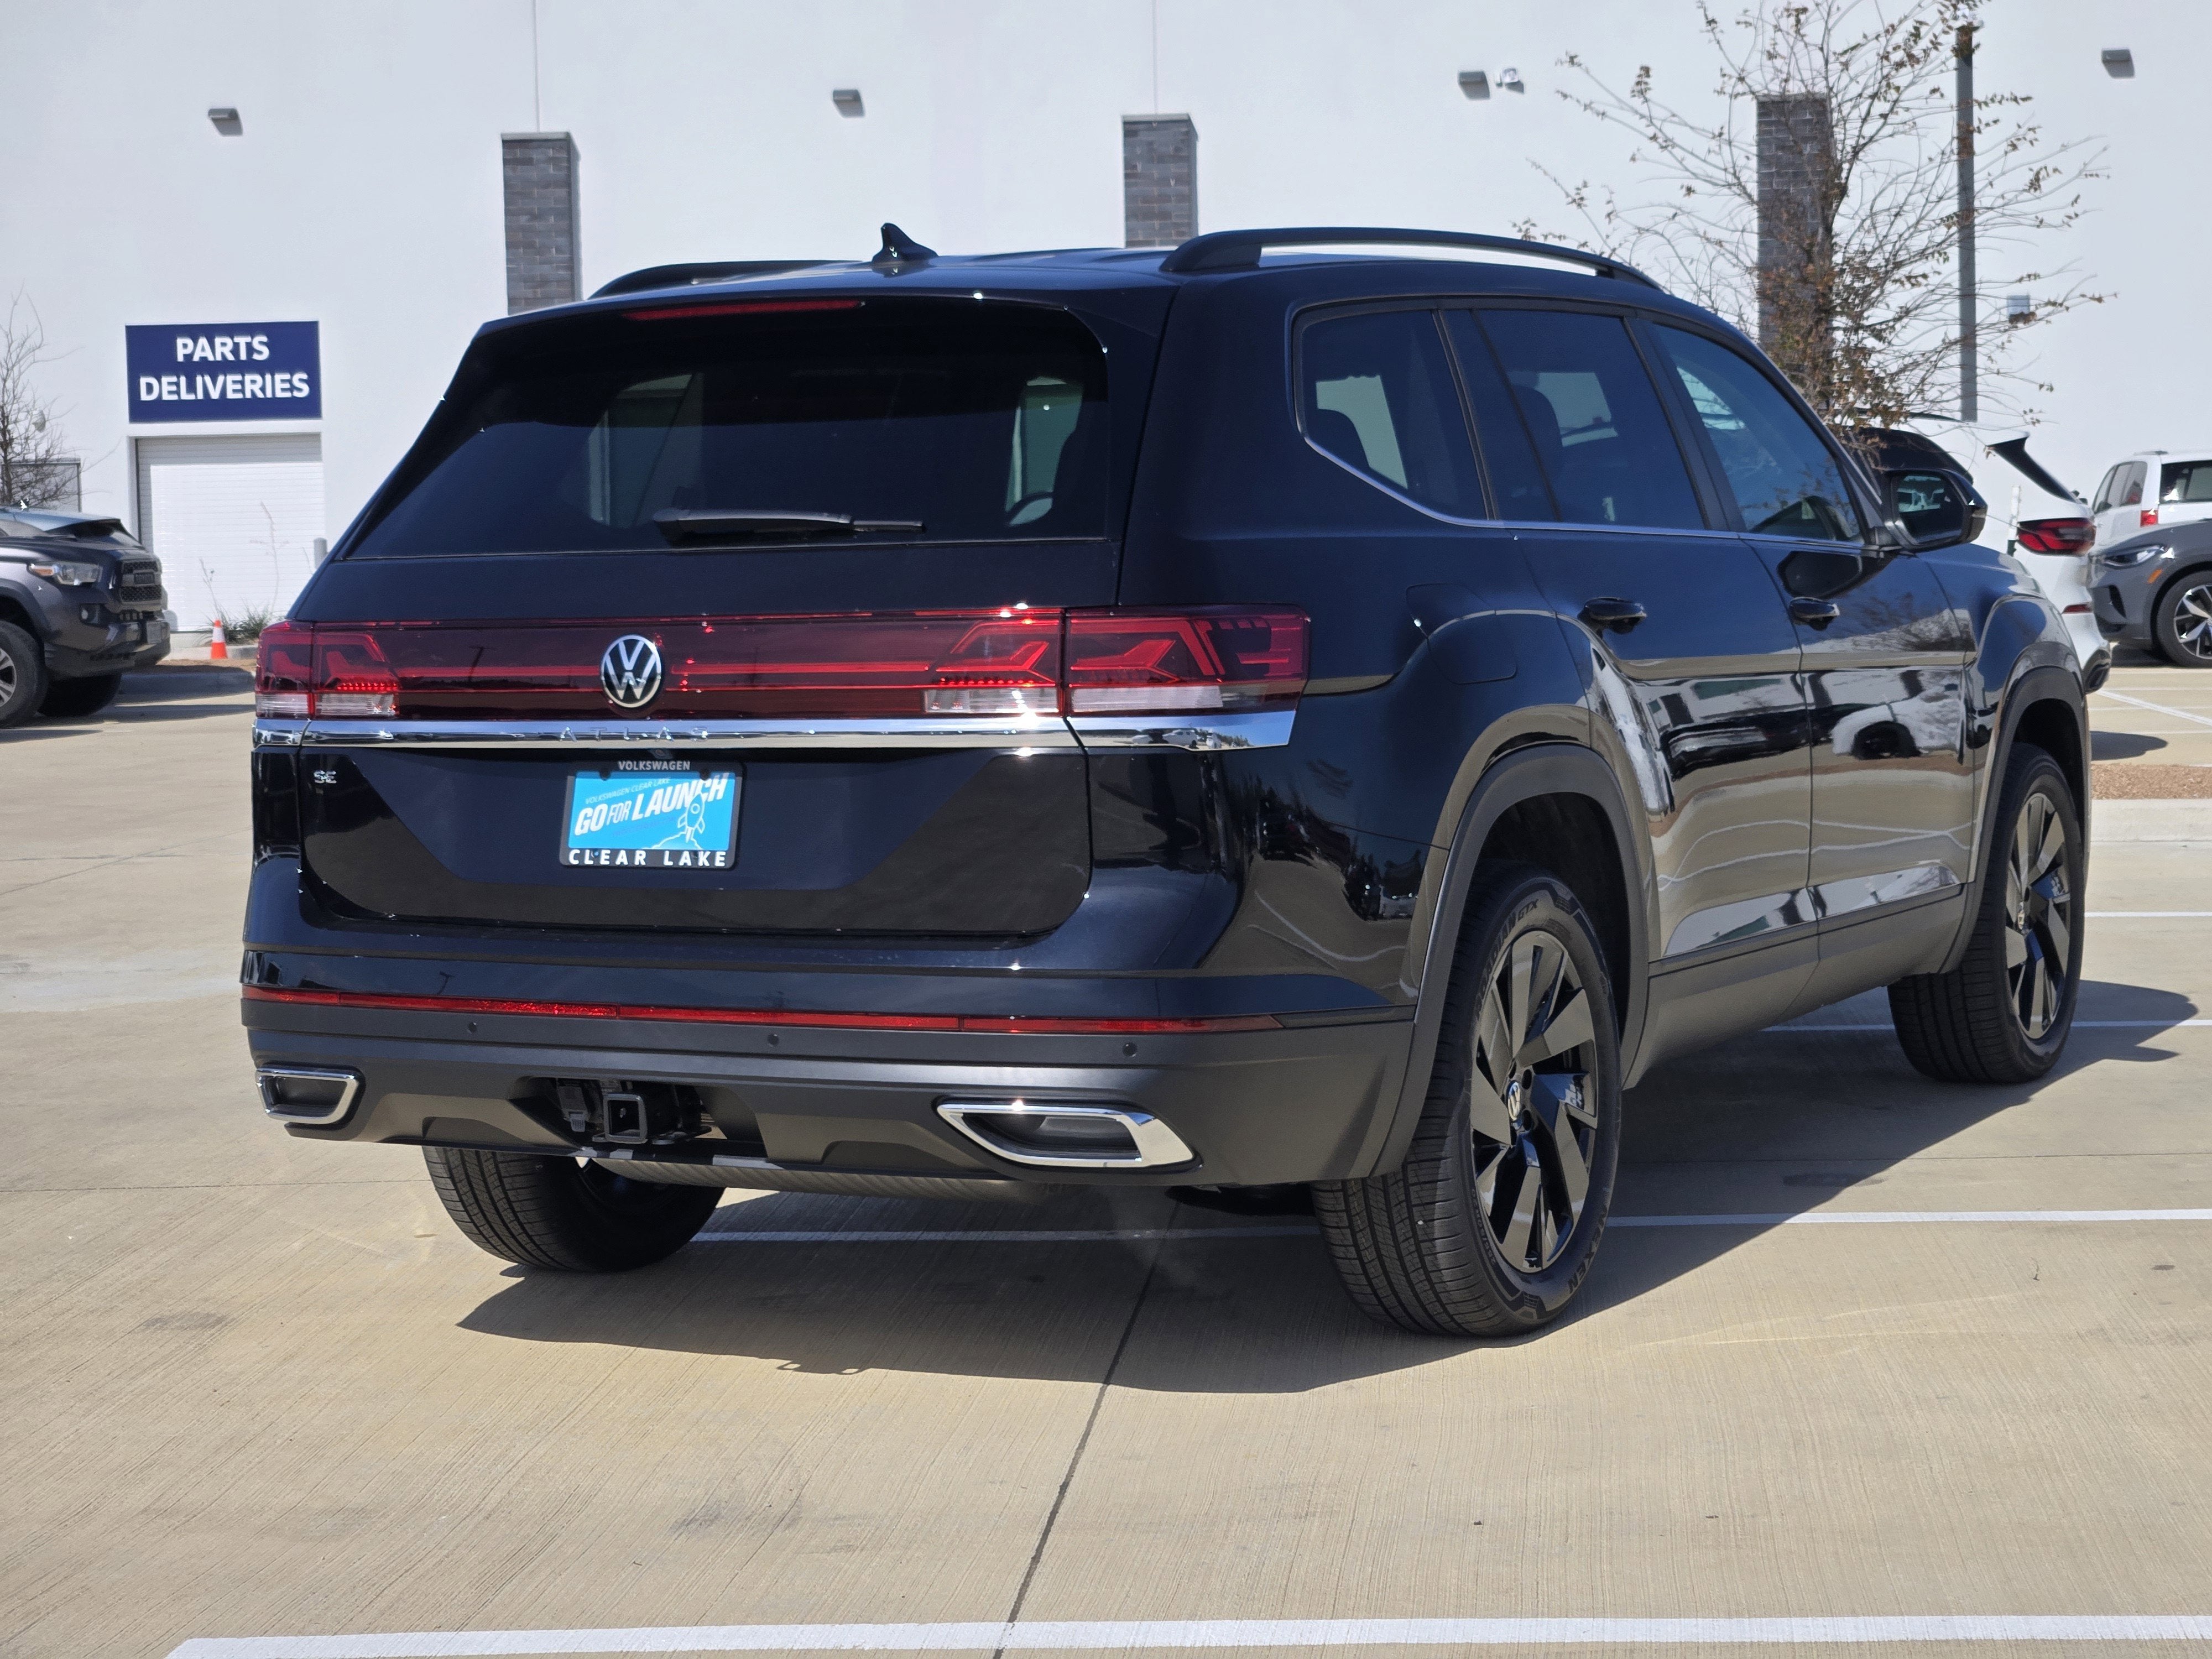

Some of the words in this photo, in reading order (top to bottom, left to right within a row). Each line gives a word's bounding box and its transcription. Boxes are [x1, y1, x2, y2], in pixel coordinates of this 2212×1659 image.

[176, 334, 270, 362] PARTS
[139, 372, 310, 401] DELIVERIES
[559, 726, 708, 743] ATLAS
[618, 760, 691, 771] VOLKSWAGEN
[314, 770, 337, 784] SE
[585, 787, 630, 805] VOLKSWAGEN
[631, 781, 653, 792] CLEAR
[653, 776, 671, 787] LAKE
[574, 804, 608, 836] GO
[606, 800, 633, 826] FOR
[631, 773, 729, 821] LAUNCH
[568, 849, 646, 865] CLEAR
[664, 849, 726, 867] LAKE
[1516, 899, 1537, 921] GTX
